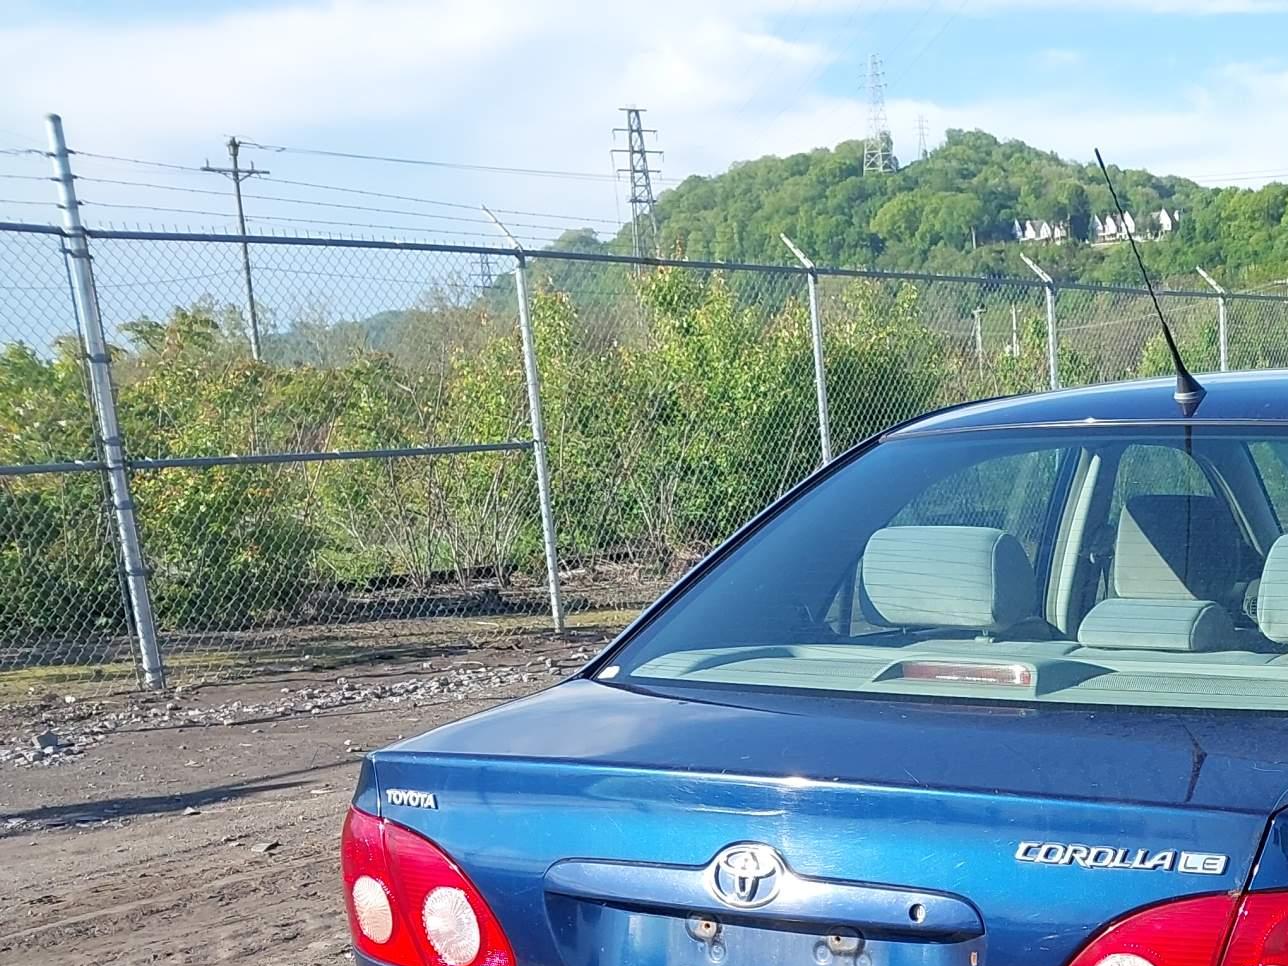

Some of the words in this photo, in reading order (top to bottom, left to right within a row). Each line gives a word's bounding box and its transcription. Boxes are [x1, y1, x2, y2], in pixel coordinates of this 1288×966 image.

[386, 789, 438, 809] TOYOTA
[1014, 841, 1177, 871] COROLLA
[1180, 852, 1225, 874] LE
